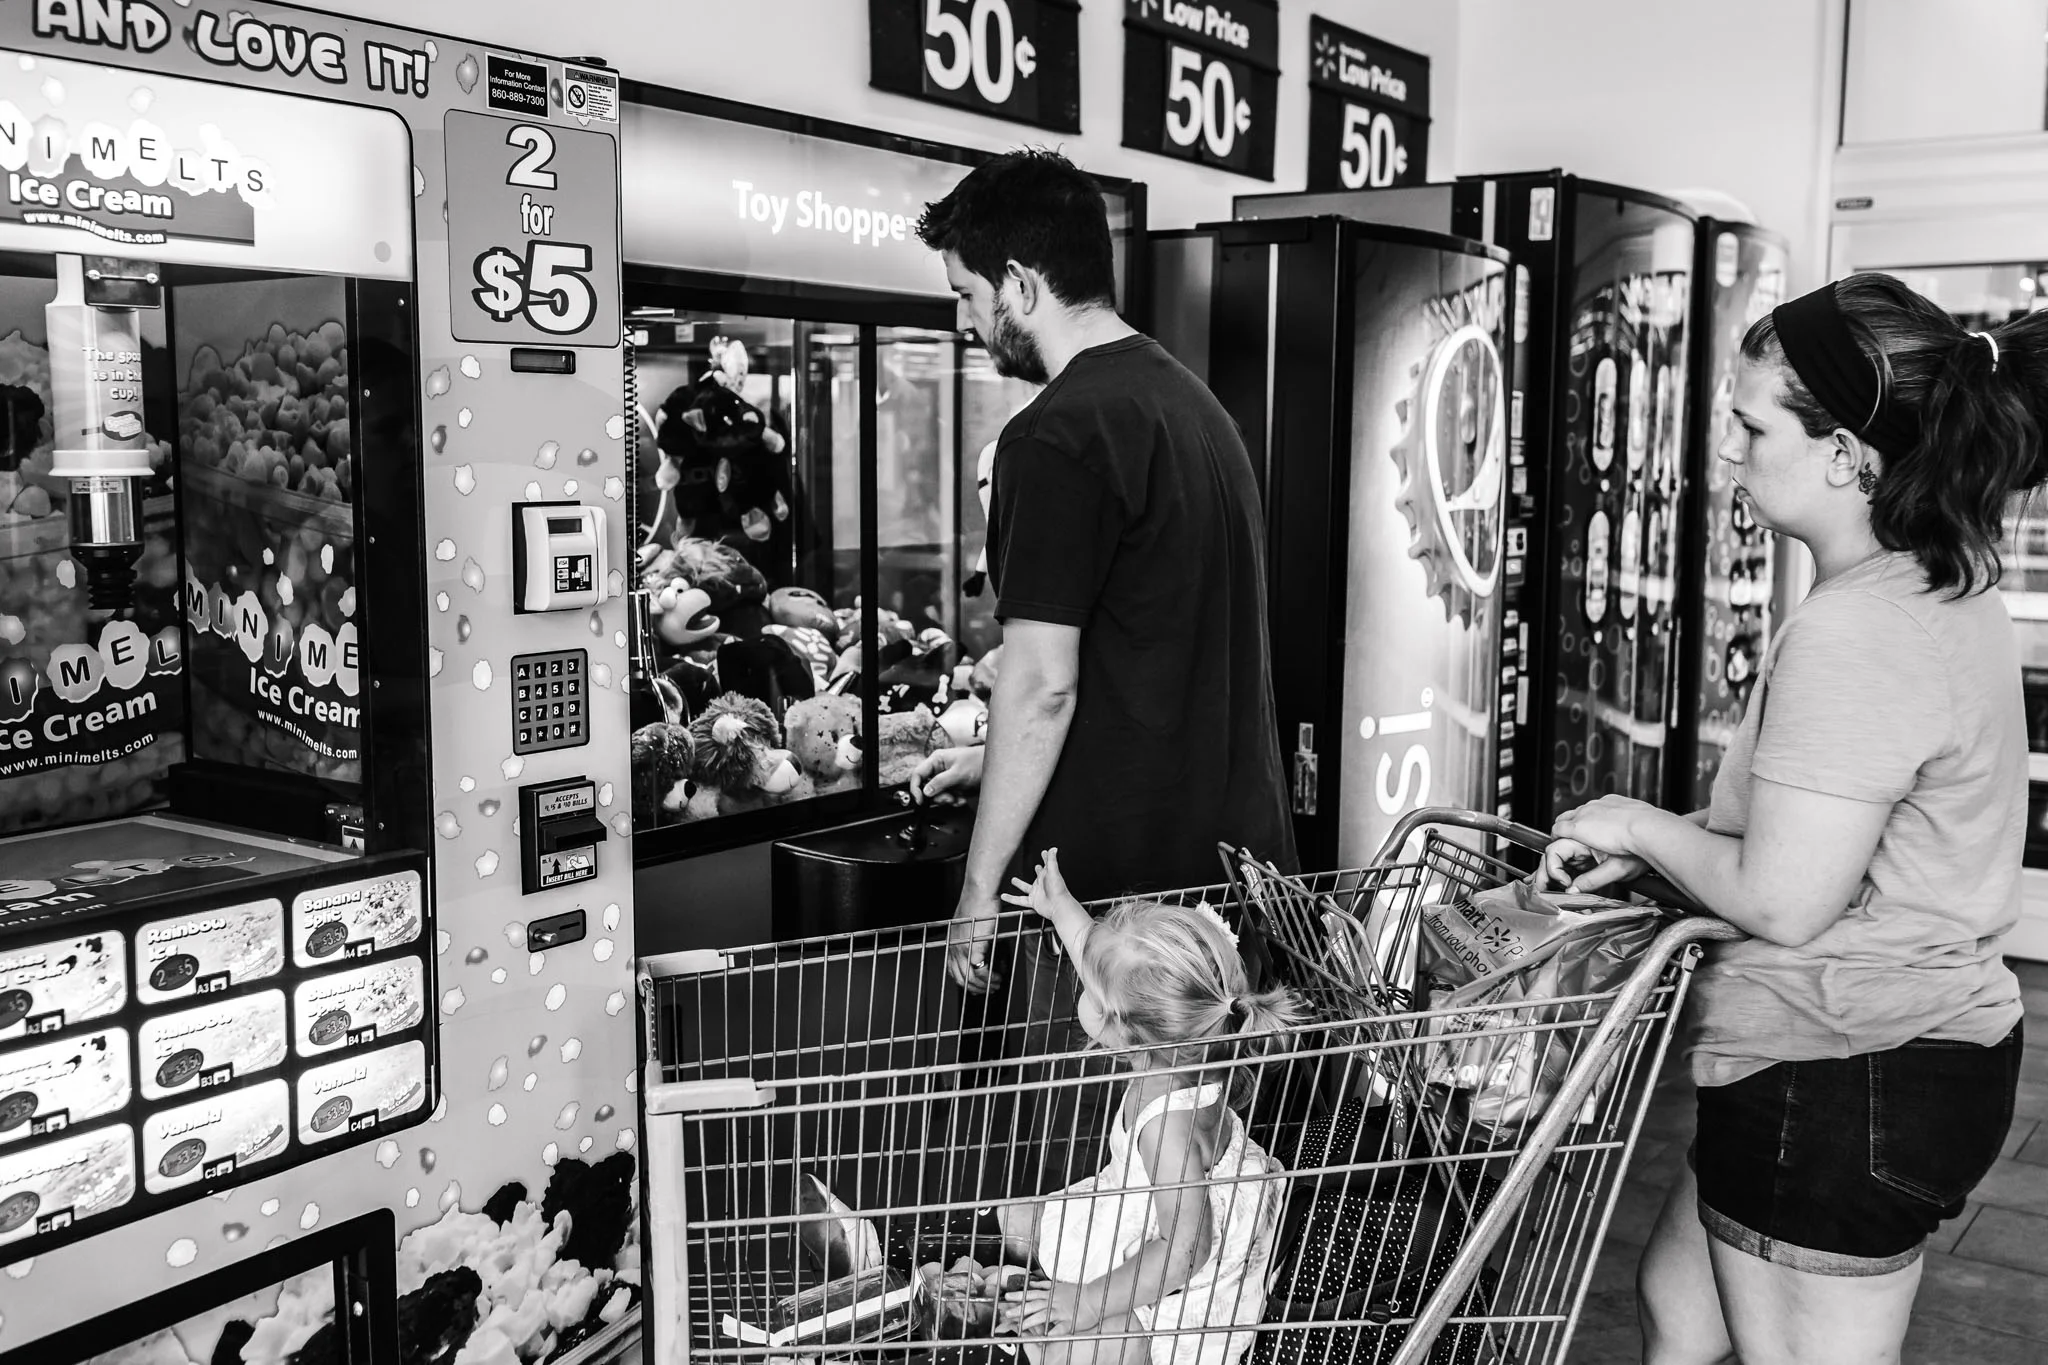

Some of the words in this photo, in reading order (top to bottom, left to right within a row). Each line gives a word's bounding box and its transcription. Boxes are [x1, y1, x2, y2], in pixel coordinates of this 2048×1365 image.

[1163, 0, 1204, 32] Low
[1205, 5, 1249, 49] Price
[32, 0, 171, 53] AND
[196, 10, 348, 84] LOVE
[364, 40, 430, 98] IT!
[924, 0, 1036, 104] 50¢
[490, 75, 522, 89] Information
[523, 82, 546, 93] Contact
[504, 69, 515, 78] For
[516, 72, 531, 82] More
[580, 73, 609, 85] WARNING
[1339, 54, 1370, 89] Low
[1370, 65, 1407, 101] Price
[491, 88, 545, 106] 860-889-7300
[1166, 46, 1251, 158] 50¢
[1340, 103, 1408, 189] 50¢
[506, 124, 558, 191] 2
[9, 172, 60, 208] Ice
[65, 179, 174, 220] Cream
[520, 193, 554, 235] for
[732, 179, 790, 235] Toy
[23, 212, 165, 243] www.minimelts.com
[472, 239, 597, 335] $5
[111, 369, 125, 382] in
[518, 667, 526, 677] A
[536, 666, 541, 675] 1
[552, 664, 558, 673] 2
[568, 662, 575, 671] 3
[250, 666, 282, 706] Ice
[519, 689, 526, 699] B
[536, 687, 542, 696] 4
[552, 684, 559, 694] 5
[569, 682, 575, 692] 6
[43, 692, 157, 742] Cream
[520, 710, 527, 720] C
[536, 708, 543, 717] 7
[553, 706, 560, 715] 8
[569, 703, 576, 713] 9
[257, 708, 357, 759] www.minimelts.com
[520, 732, 527, 742] D
[554, 727, 560, 736] 0
[0, 733, 154, 775] www.minimelts.com
[555, 793, 579, 802] ACCEPTS
[572, 798, 588, 806] BILLS
[302, 890, 362, 913] Banana
[147, 919, 227, 945] Rainbow
[323, 926, 346, 946] $3.50
[149, 944, 178, 962] Ice
[344, 948, 355, 959] A4
[156, 970, 167, 987] 2
[178, 958, 193, 976] $5
[196, 983, 209, 994] A3
[326, 1014, 349, 1034] $3.50
[348, 1034, 360, 1046] B4
[200, 1076, 213, 1088] B3
[326, 1099, 351, 1120] $3.50
[350, 1121, 360, 1132] C4
[204, 1168, 217, 1179] C3
